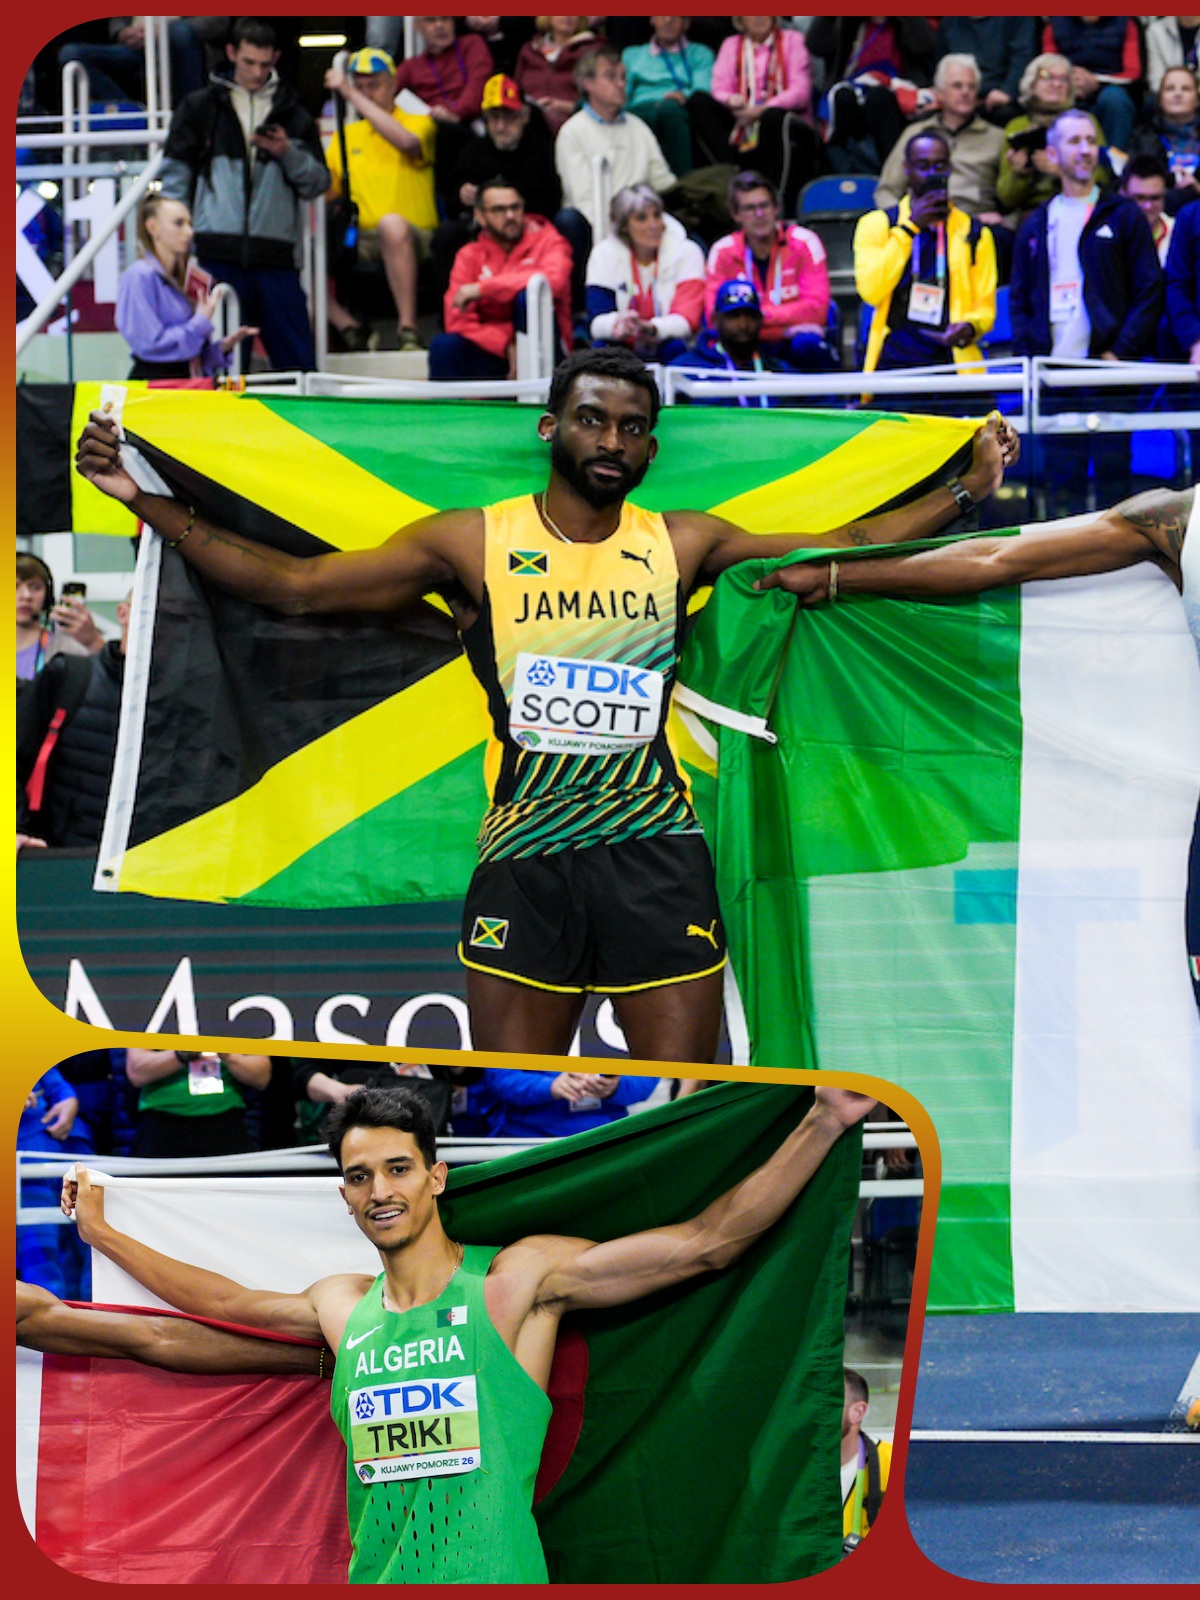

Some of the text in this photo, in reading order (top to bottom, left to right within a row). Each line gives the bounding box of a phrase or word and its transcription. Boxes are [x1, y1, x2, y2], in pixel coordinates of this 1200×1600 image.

[514, 590, 660, 624] JAMAICA
[557, 661, 651, 699] TDK
[520, 694, 651, 733] SCOTT
[547, 737, 587, 748] KUJAWY
[354, 1335, 465, 1379] ALGERIA
[374, 1381, 465, 1416] TDK
[367, 1417, 452, 1454] TRIKI
[380, 1456, 475, 1475] KUJAWY POMORZE 26
